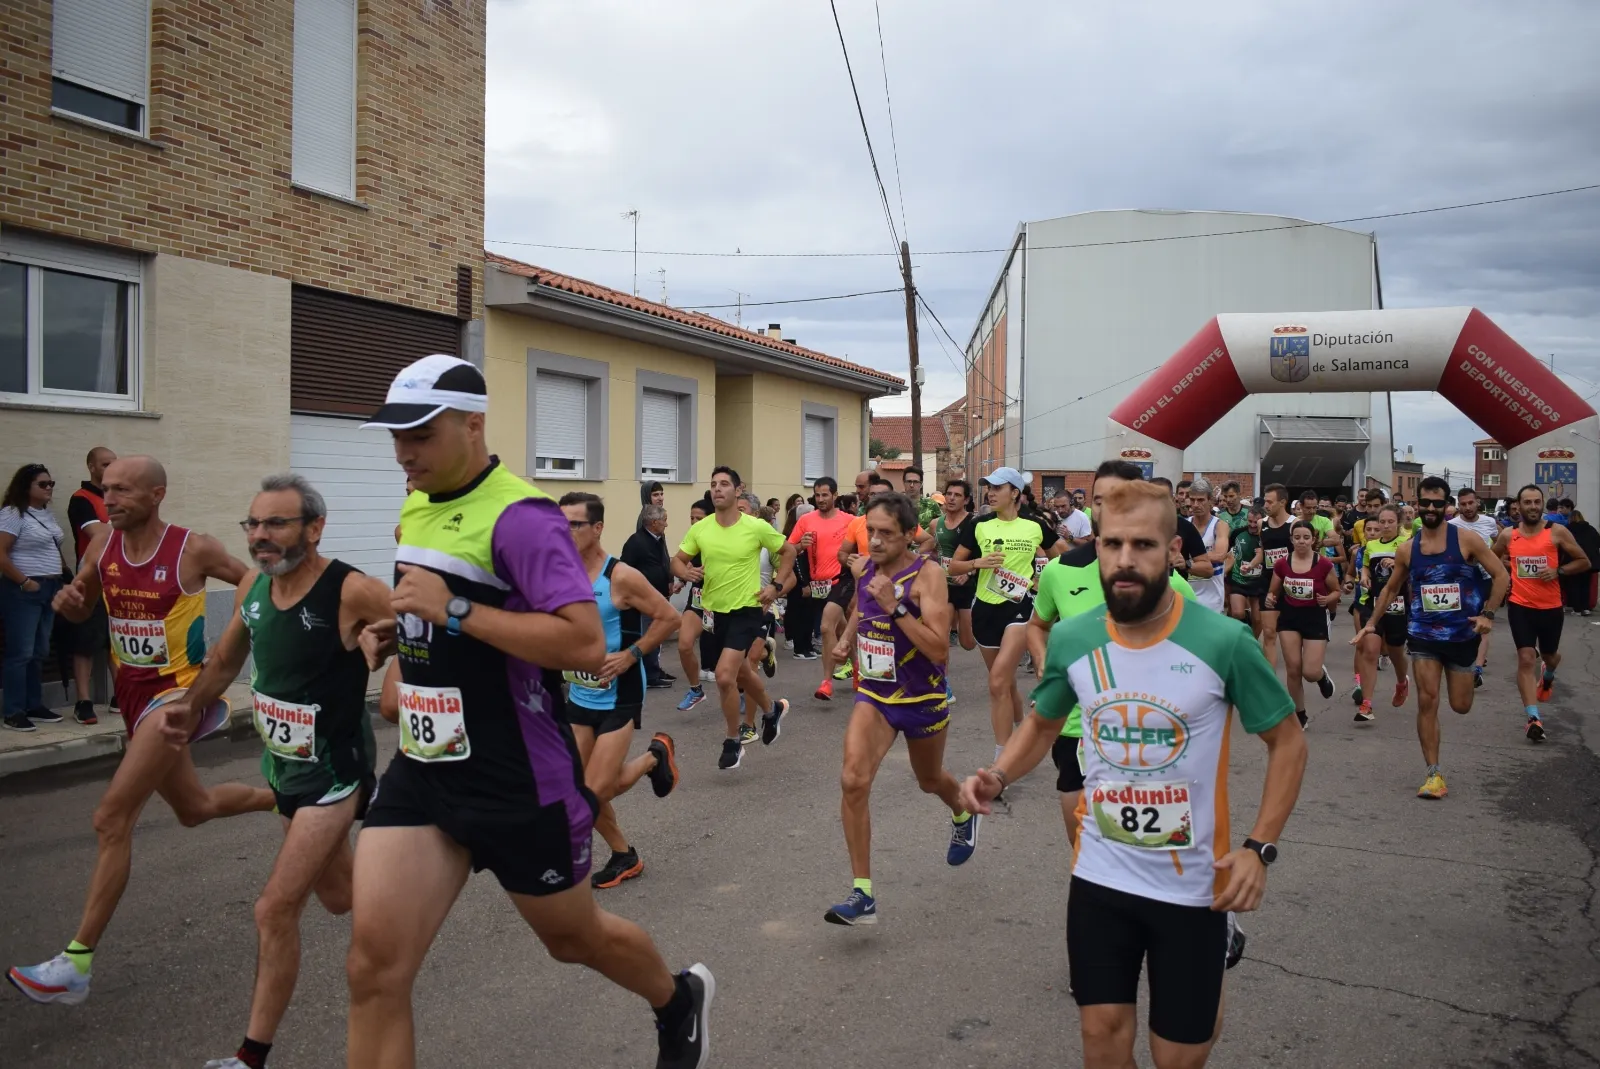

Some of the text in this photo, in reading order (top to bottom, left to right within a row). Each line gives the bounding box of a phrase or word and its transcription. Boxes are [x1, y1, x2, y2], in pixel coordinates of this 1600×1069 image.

[1313, 330, 1393, 348] Diputación
[1312, 358, 1409, 372] de Salamanca
[1132, 347, 1224, 429] CON EL DEPORTE
[1467, 345, 1560, 422] CON NUESTROS
[1460, 360, 1542, 430] DEPORTISTAS
[993, 567, 1028, 588] bedunia
[1000, 579, 1015, 593] 99
[1284, 579, 1312, 587] bedunia
[1292, 586, 1303, 594] 83
[1422, 585, 1459, 594] bedunia
[1433, 594, 1448, 604] 34
[120, 601, 144, 611] VINO
[111, 620, 165, 636] bedunia
[120, 636, 153, 655] 106
[867, 654, 872, 669] 1
[254, 695, 313, 726] bedunia
[1086, 692, 1190, 720] CLUB DEPORTIVO
[266, 717, 291, 743] 73
[410, 713, 435, 743] 88
[1097, 724, 1177, 747] ALCER
[1092, 785, 1188, 805] bedunia
[1121, 806, 1161, 833] 82
